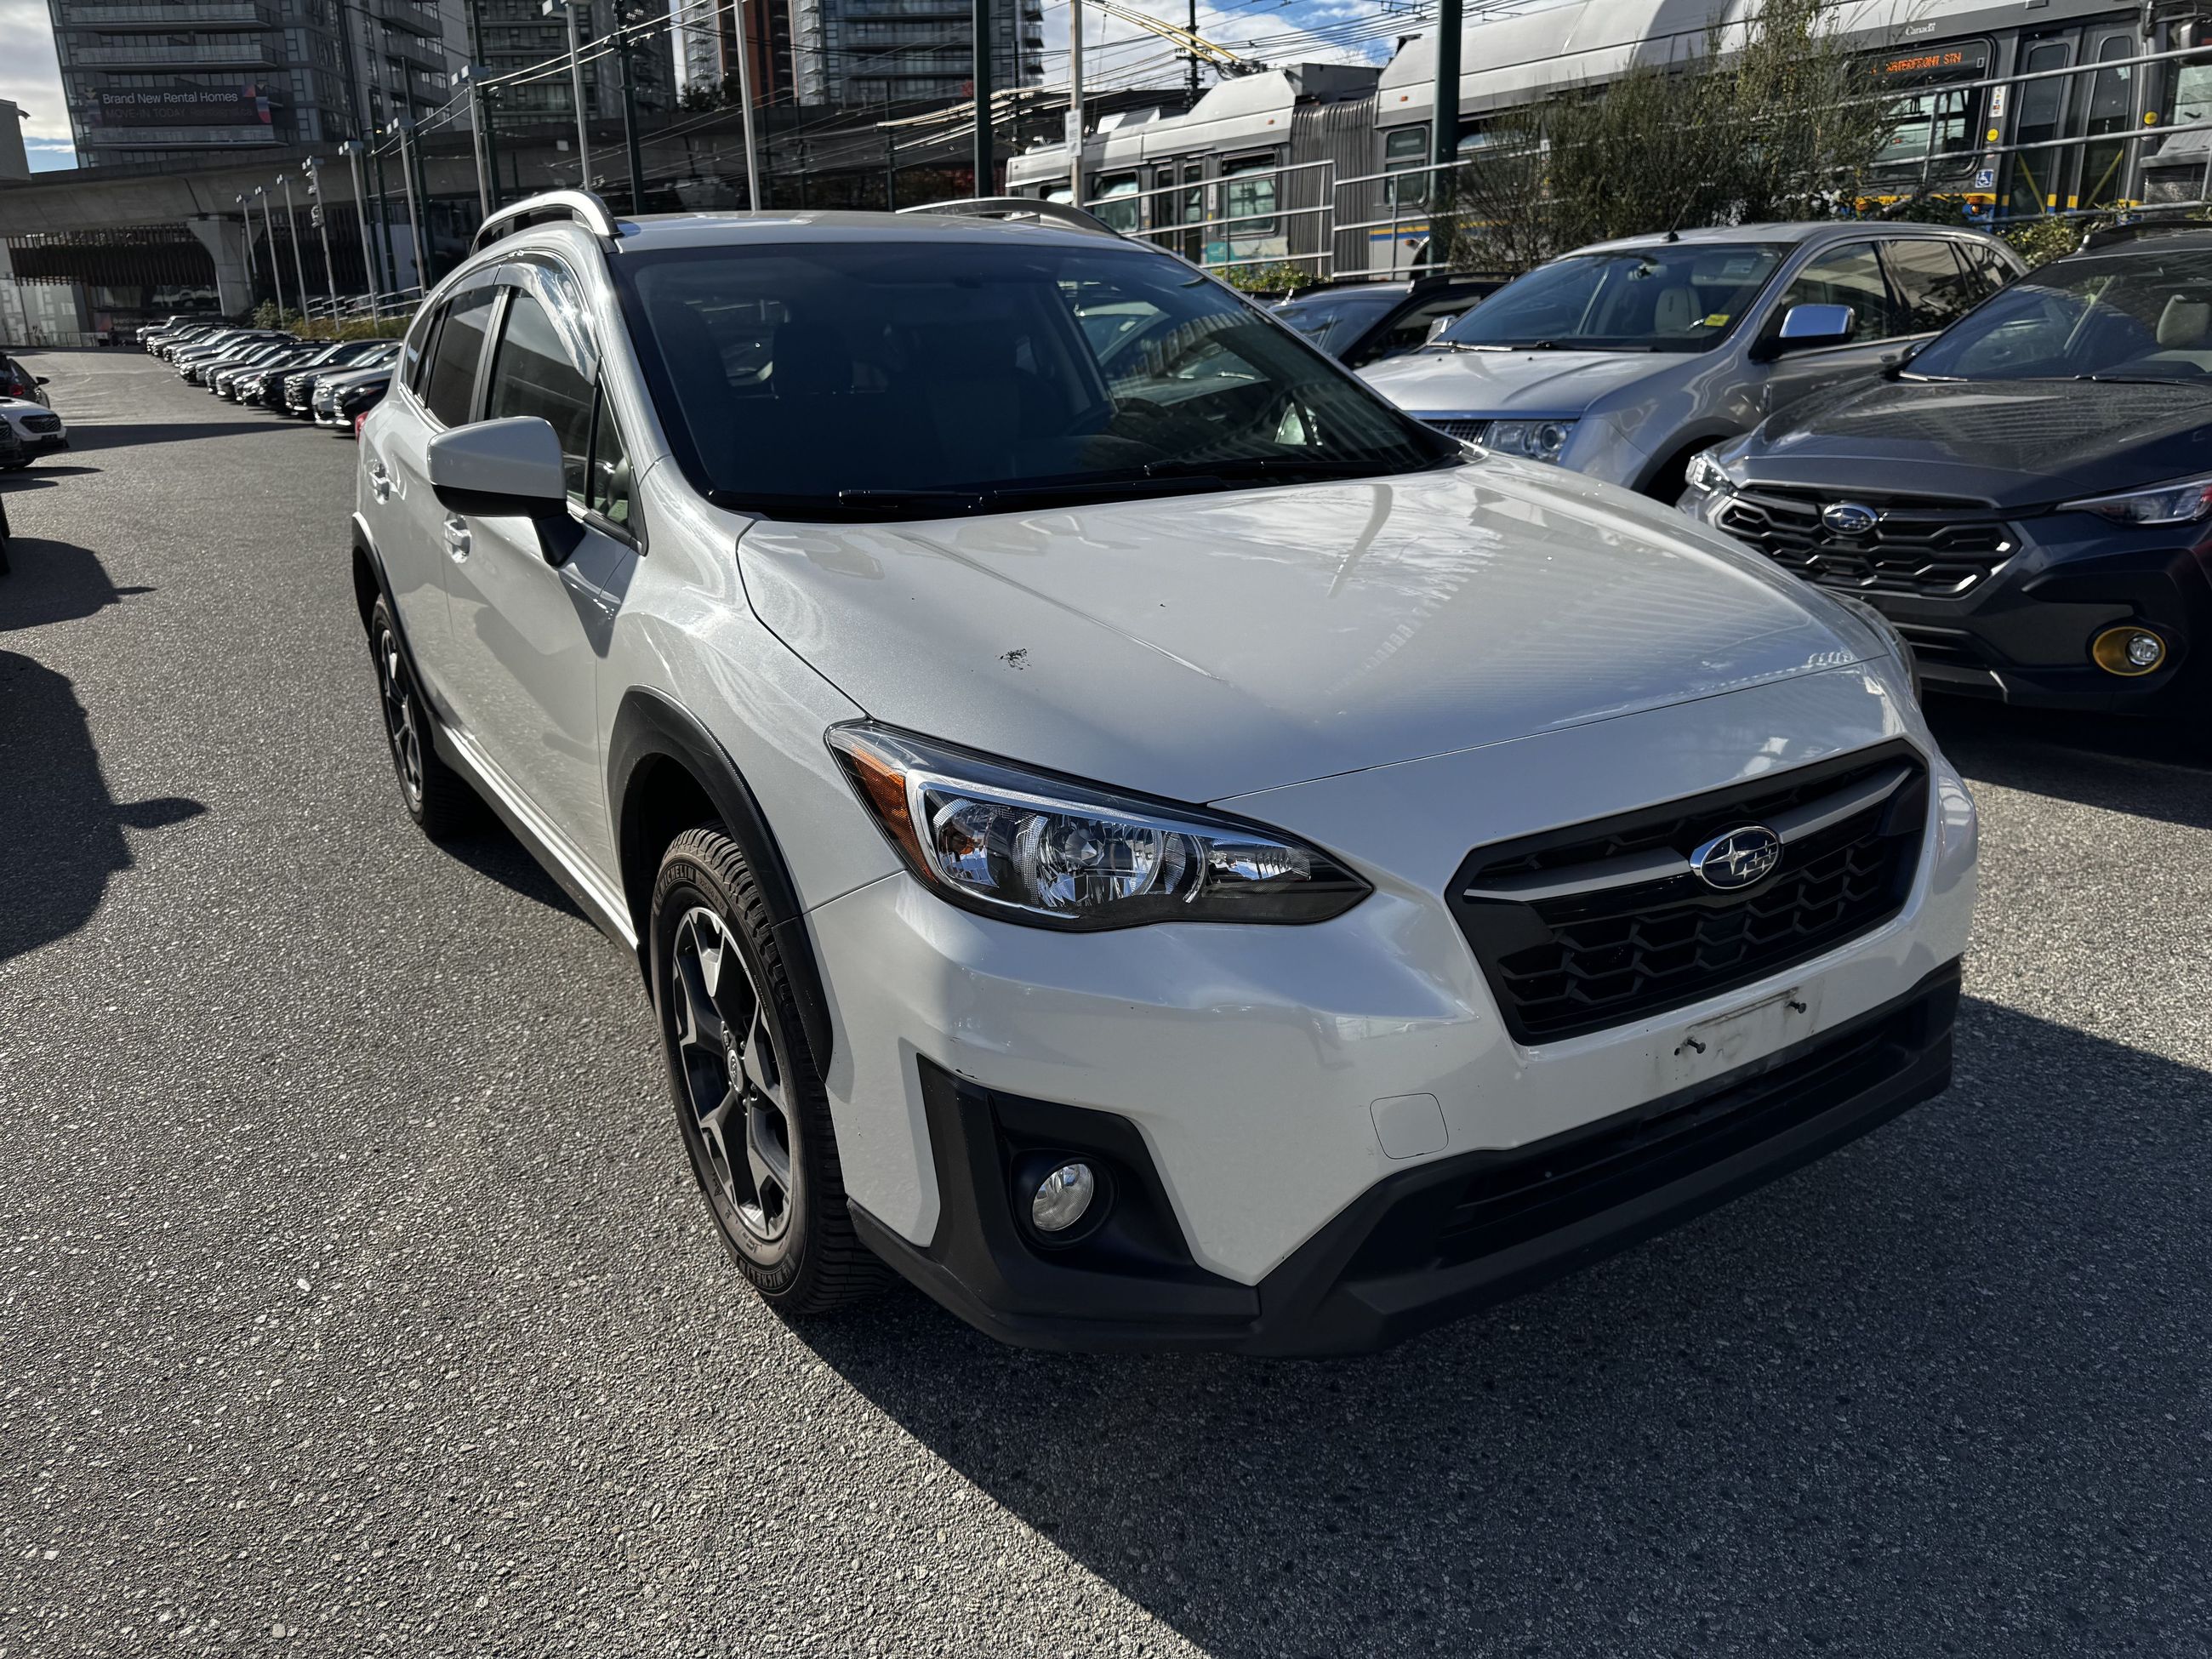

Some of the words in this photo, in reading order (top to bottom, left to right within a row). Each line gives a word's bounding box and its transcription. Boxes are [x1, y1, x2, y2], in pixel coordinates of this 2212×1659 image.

[1906, 23, 1936, 35] Canada
[102, 93, 134, 104] Brand
[137, 93, 161, 104] New
[163, 91, 197, 103] Rental
[200, 92, 238, 102] Homes
[153, 107, 185, 117] TODAY
[660, 864, 694, 895] MICHELIN
